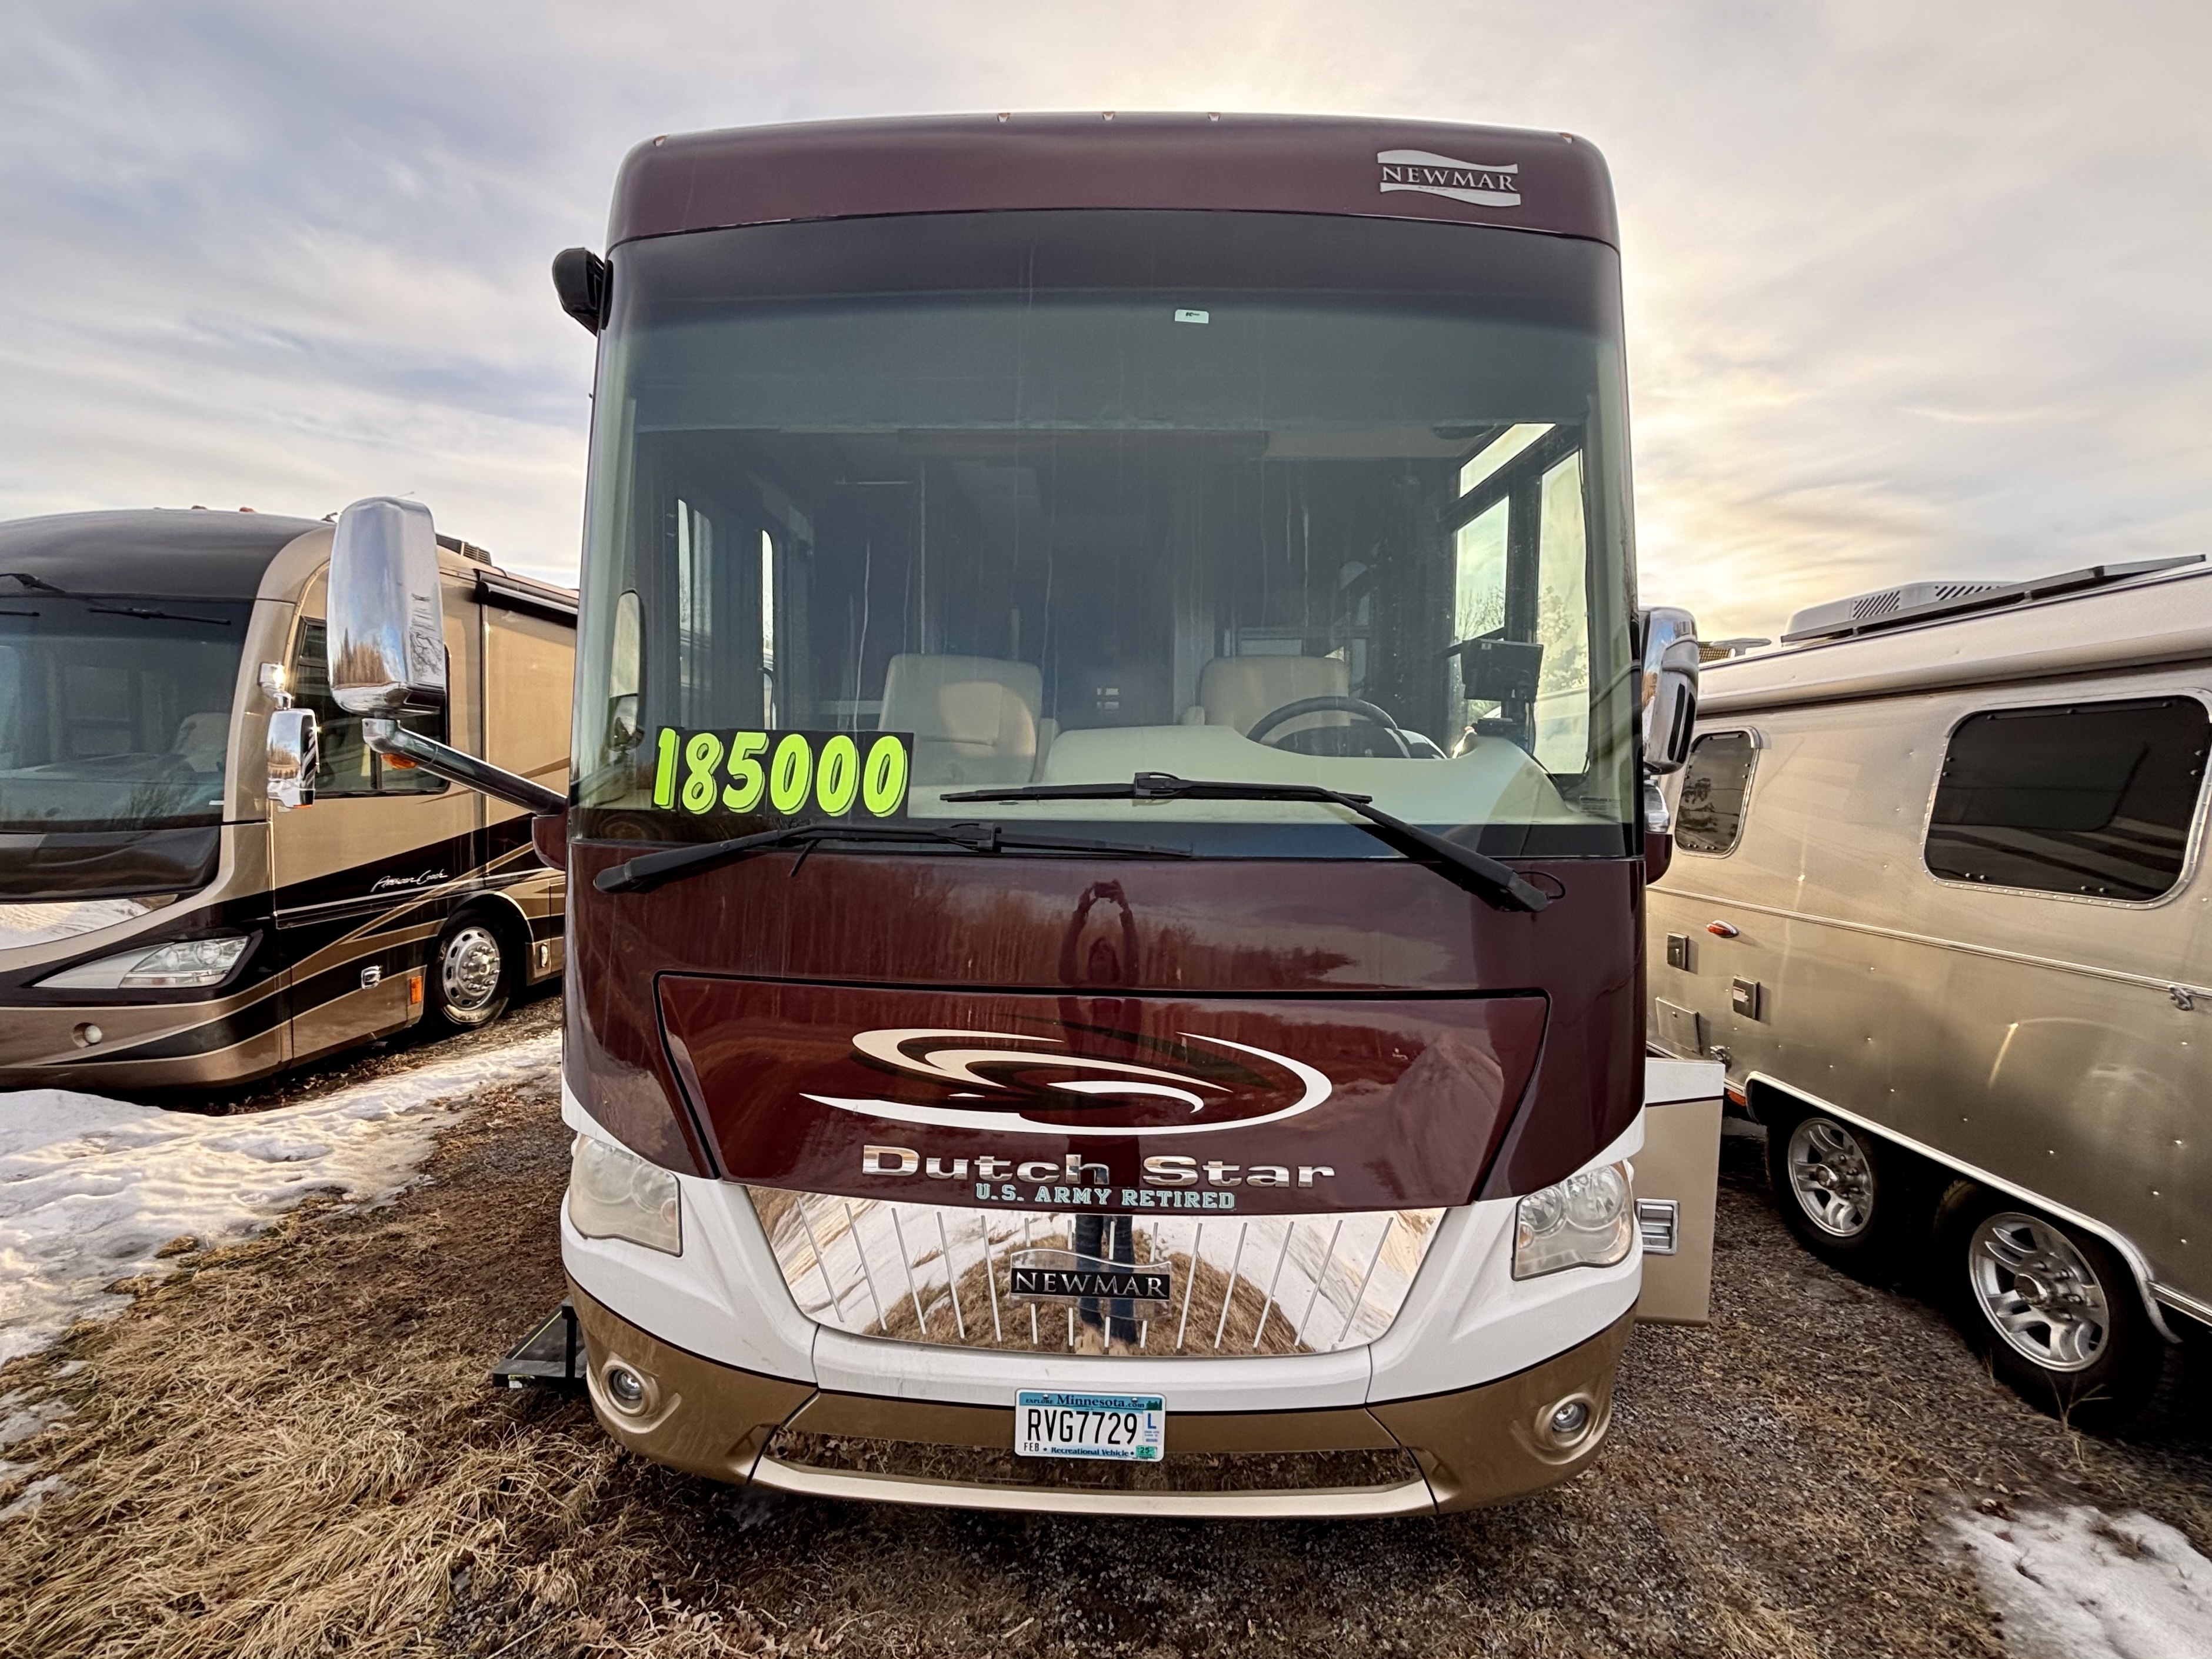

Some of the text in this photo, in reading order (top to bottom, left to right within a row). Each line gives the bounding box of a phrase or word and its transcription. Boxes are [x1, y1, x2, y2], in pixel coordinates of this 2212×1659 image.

[1382, 166, 1518, 192] NEWMAR
[653, 727, 908, 818] 185000
[862, 1144, 1335, 1187] Dutch Star
[975, 1182, 1235, 1209] U.S. ARMY RETIRED
[1014, 1271, 1167, 1297] NEWMAR
[1027, 1408, 1138, 1445] RVG7729
[1148, 1413, 1157, 1429] L
[1024, 1442, 1040, 1452] FEB
[1051, 1447, 1130, 1457] Recreational Vehicle
